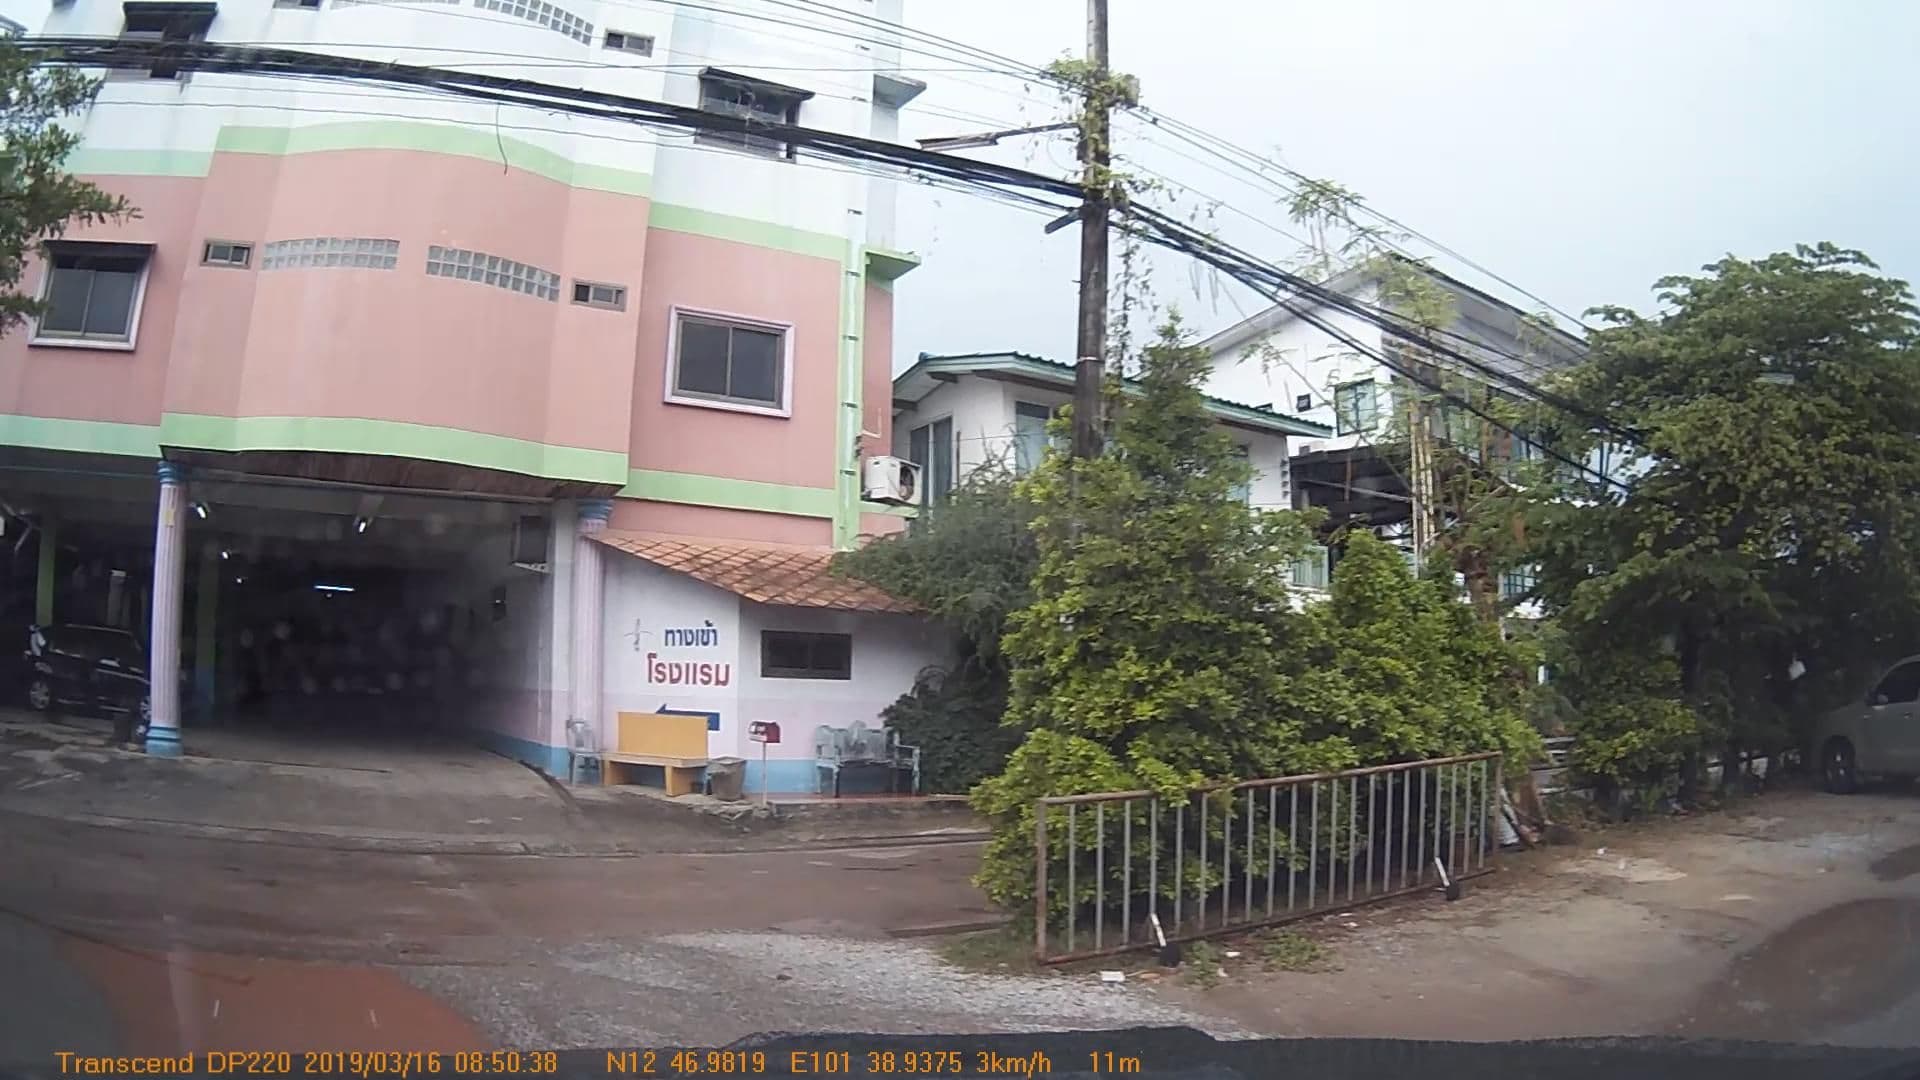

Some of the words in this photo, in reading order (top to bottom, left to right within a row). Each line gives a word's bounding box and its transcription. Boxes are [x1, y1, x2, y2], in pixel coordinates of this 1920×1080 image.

[664, 619, 718, 646] ทางเข้า
[647, 652, 730, 686] โรงแรม
